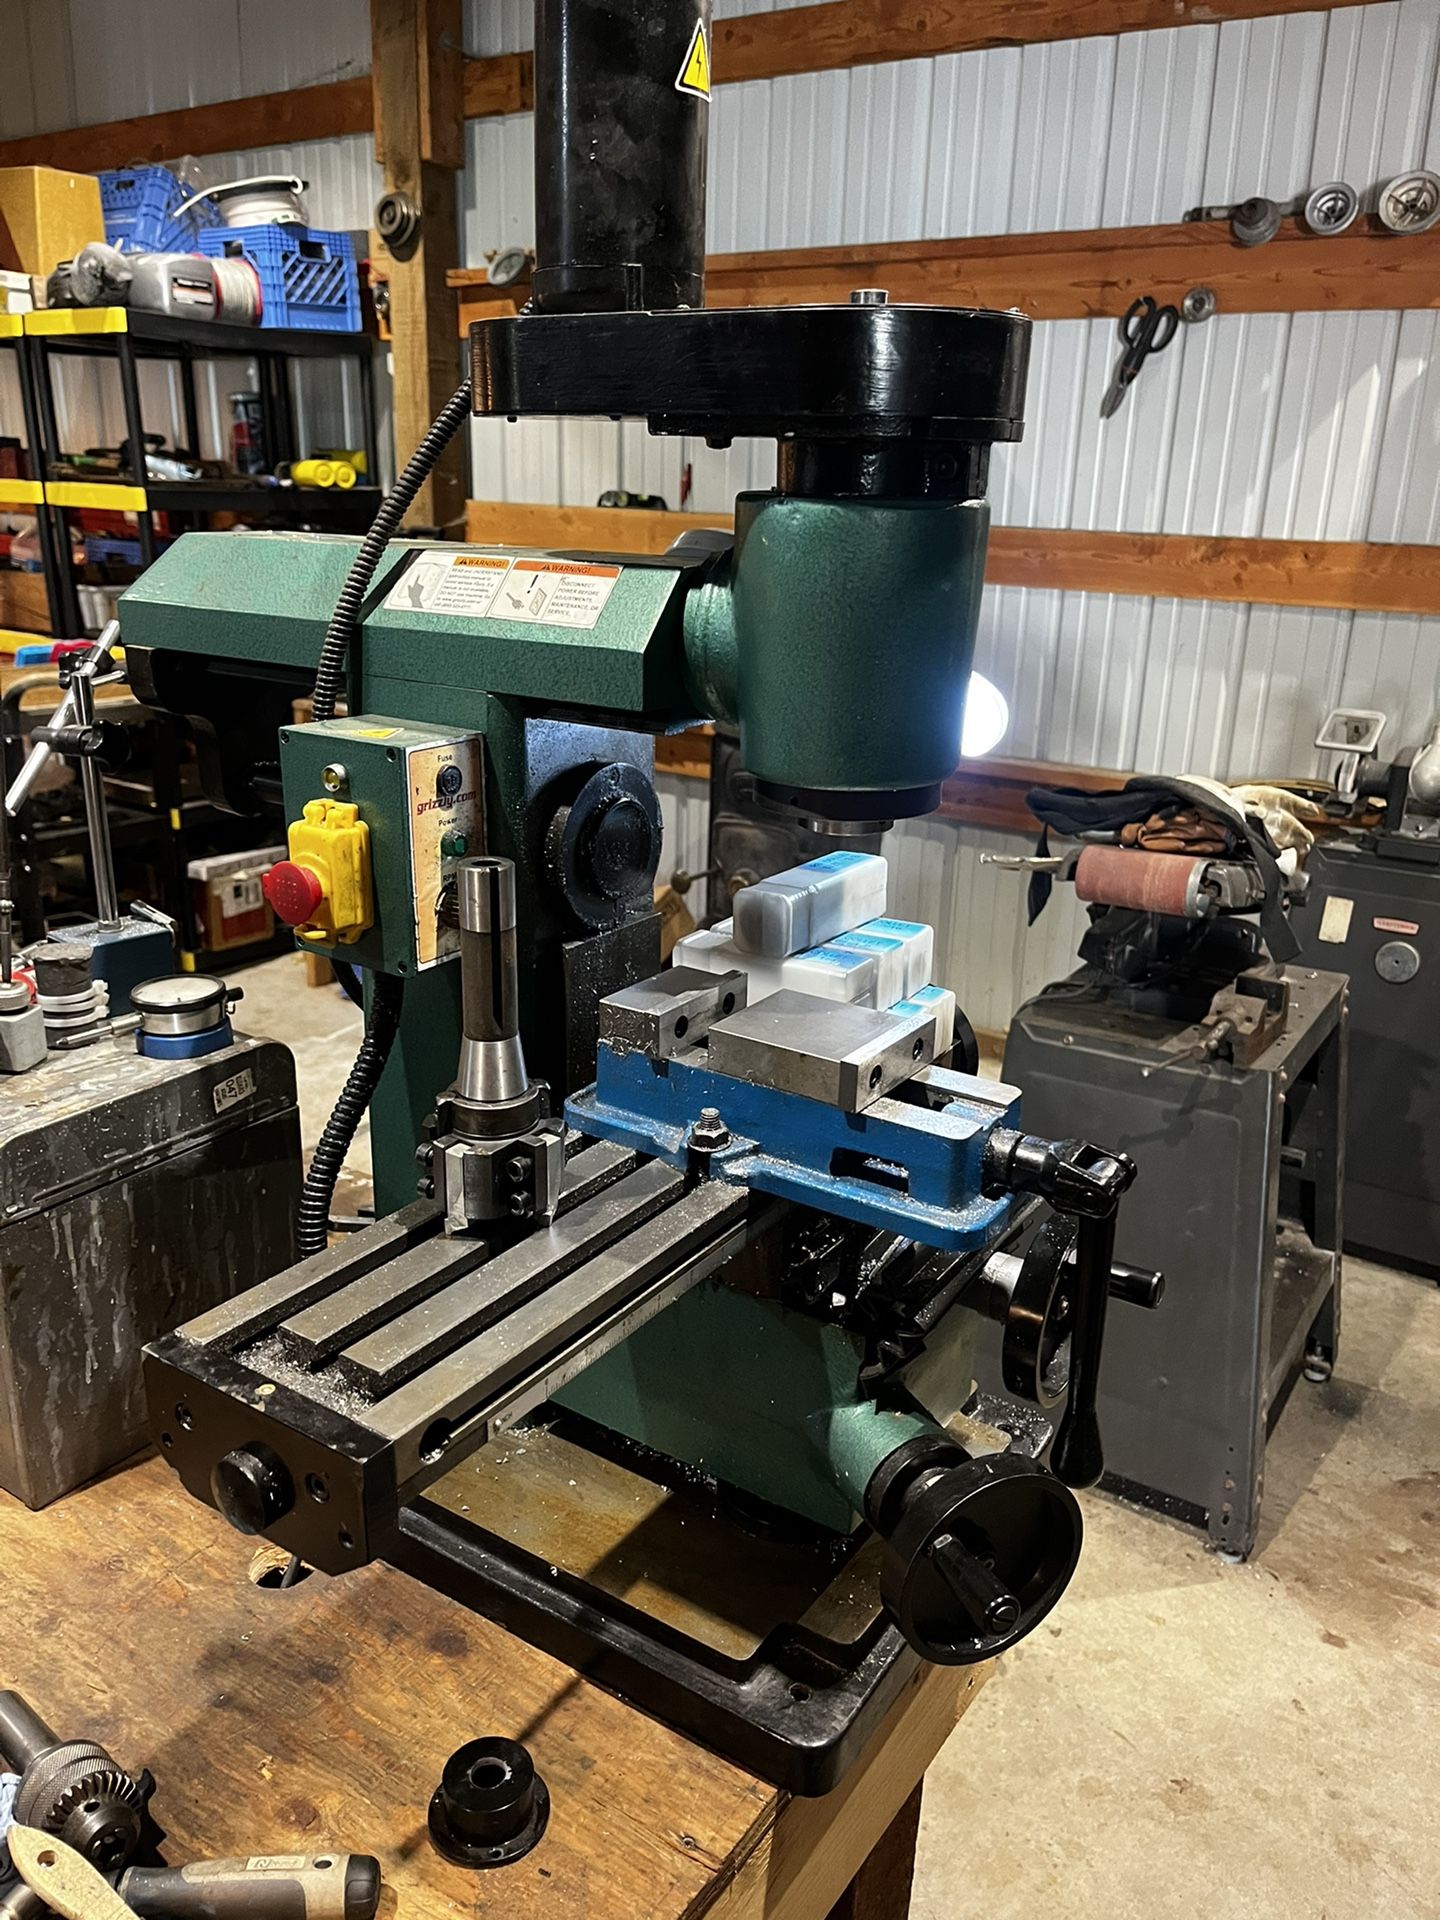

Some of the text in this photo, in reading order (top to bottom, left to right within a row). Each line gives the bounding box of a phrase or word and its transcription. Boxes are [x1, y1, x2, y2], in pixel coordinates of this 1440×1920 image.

[468, 559, 506, 568] WARNING!
[551, 564, 592, 574] WARNING!
[437, 754, 453, 762] Fuse
[416, 789, 477, 816] grizzly.com
[438, 816, 458, 827] Power
[443, 871, 457, 881] RPM
